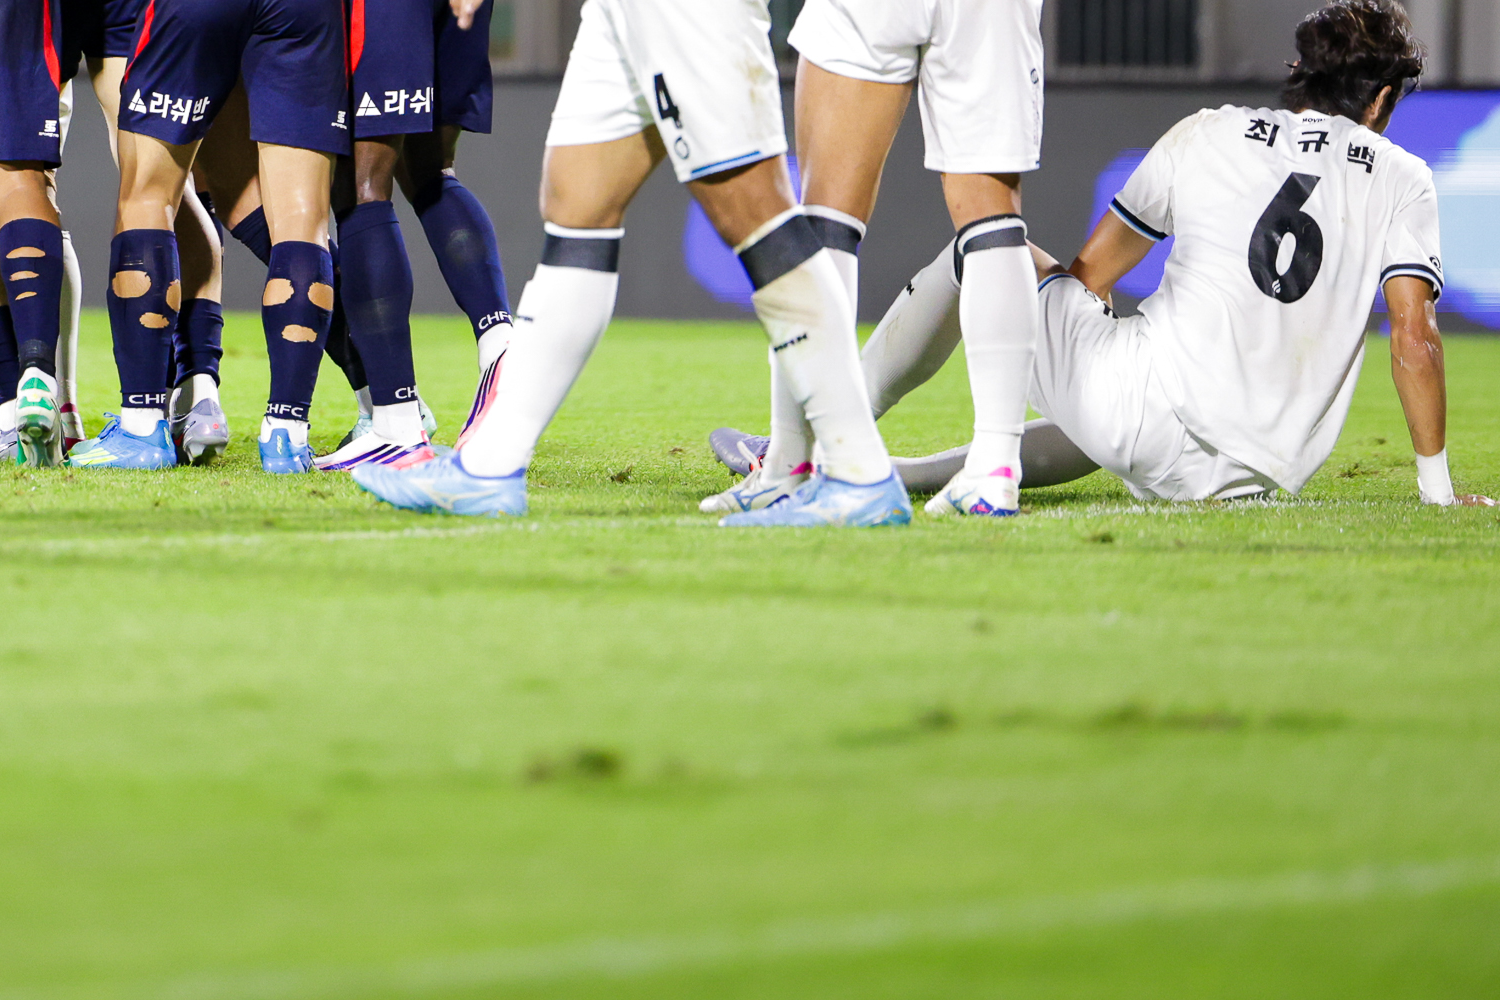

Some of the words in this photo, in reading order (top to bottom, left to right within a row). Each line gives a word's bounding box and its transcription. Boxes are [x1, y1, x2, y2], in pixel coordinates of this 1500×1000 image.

[149, 91, 211, 124] 라쉬반
[384, 86, 434, 115] 라쉬
[654, 72, 683, 130] 4
[1244, 117, 1376, 174] 최규백
[1248, 171, 1325, 304] 6
